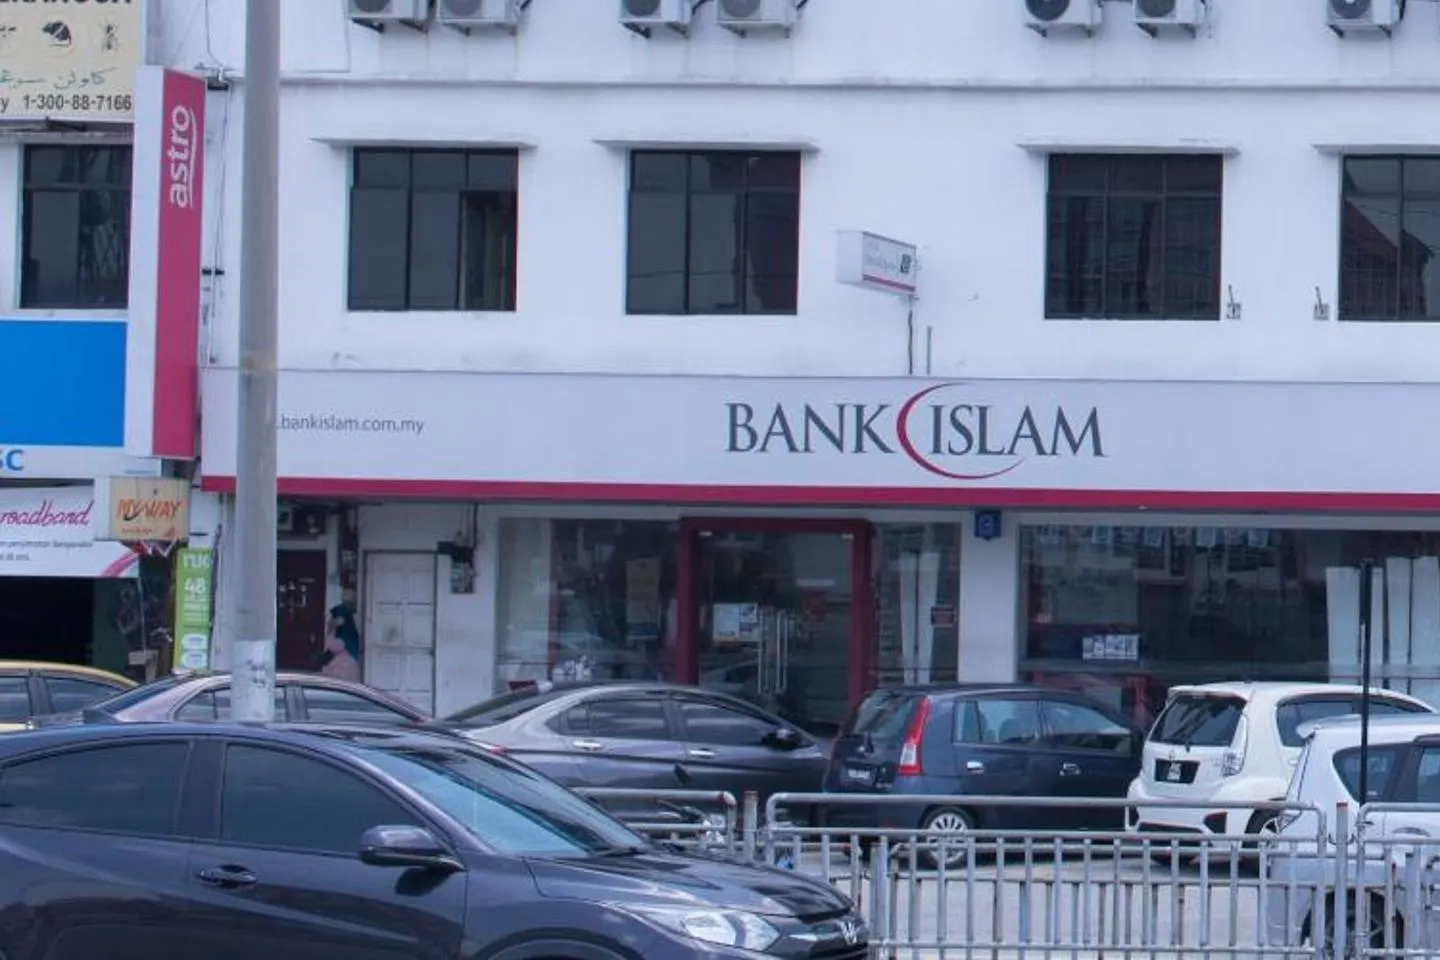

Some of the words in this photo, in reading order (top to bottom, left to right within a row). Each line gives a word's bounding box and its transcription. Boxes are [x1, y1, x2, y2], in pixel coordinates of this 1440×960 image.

[23, 94, 132, 112] 1-300-88-7166
[167, 105, 191, 208] astro
[724, 402, 896, 454] BANK
[929, 405, 1108, 457] ISLAM
[0, 449, 24, 471] C
